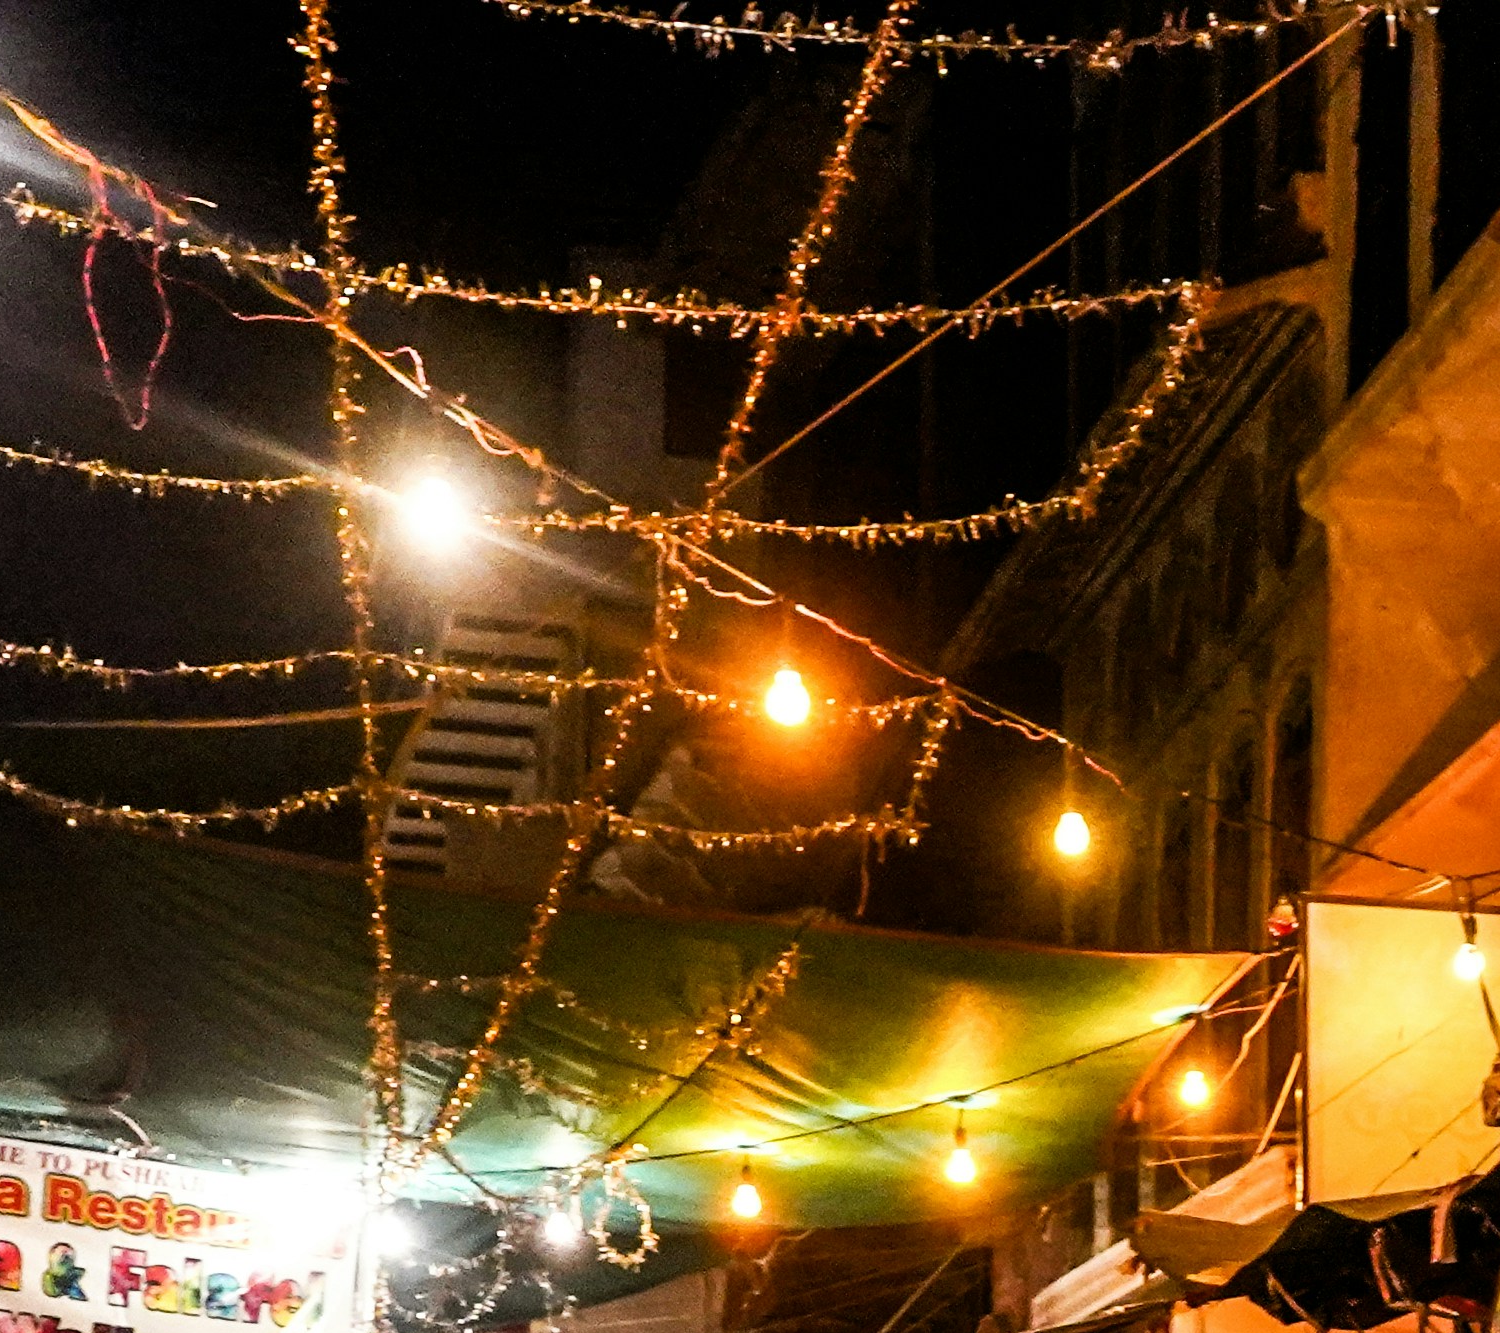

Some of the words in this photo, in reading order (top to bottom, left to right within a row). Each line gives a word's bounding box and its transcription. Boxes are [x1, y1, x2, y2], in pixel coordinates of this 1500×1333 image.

[36, 1149, 73, 1176] TO
[41, 1241, 89, 1301] &
[107, 1245, 328, 1331] Falafel
